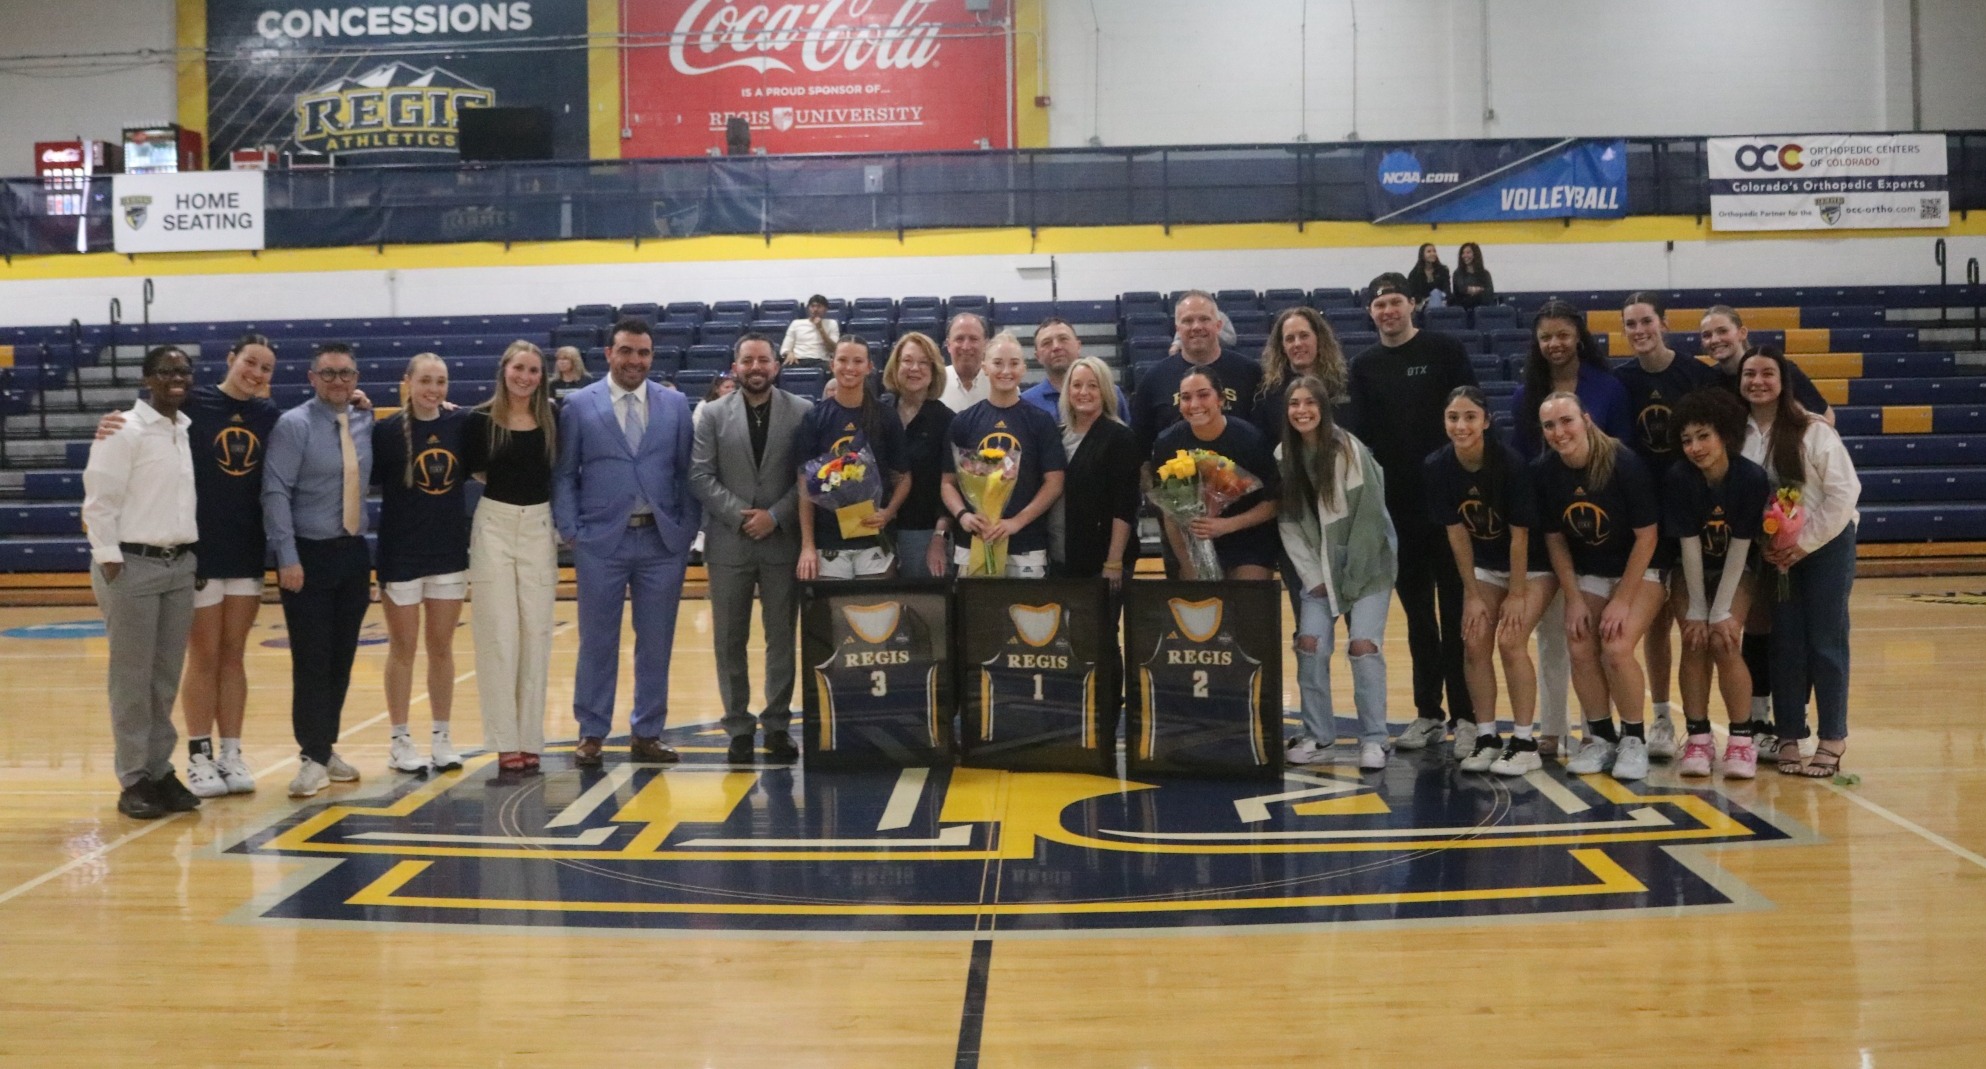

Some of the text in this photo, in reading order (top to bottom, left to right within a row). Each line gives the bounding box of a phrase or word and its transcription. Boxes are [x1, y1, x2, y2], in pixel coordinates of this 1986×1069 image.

[257, 2, 533, 39] CONCESSIONS
[669, 0, 941, 75] Coca-Cola
[741, 88, 752, 97] IS
[755, 88, 764, 97] A
[766, 86, 806, 97] PROUD
[808, 85, 862, 96] SPONSOR
[795, 106, 923, 124] UNIVERSITY
[325, 133, 457, 150] ATHLETICS
[1735, 143, 1804, 172] OCC
[1809, 145, 1921, 156] ORTHOPEDIC CENTERS
[1810, 158, 1880, 168] OF COLORADO
[1382, 172, 1459, 184] NCAA.com
[1732, 179, 1926, 193] Colorado's Orthopedic Experts
[176, 193, 239, 209] HOME
[1501, 185, 1619, 211] VOLLEYBALL
[1718, 210, 1758, 218] Orthopedic
[1760, 209, 1786, 217] Partner
[1788, 209, 1798, 217] for
[1846, 204, 1916, 214] occ-ortho.com
[163, 212, 253, 231] SEATING
[844, 649, 910, 668] REGIS
[1007, 653, 1069, 669] REGIS
[1167, 649, 1232, 666] REGIS
[870, 670, 887, 697] 3
[1032, 673, 1044, 700] 1
[1192, 669, 1209, 698] 2
